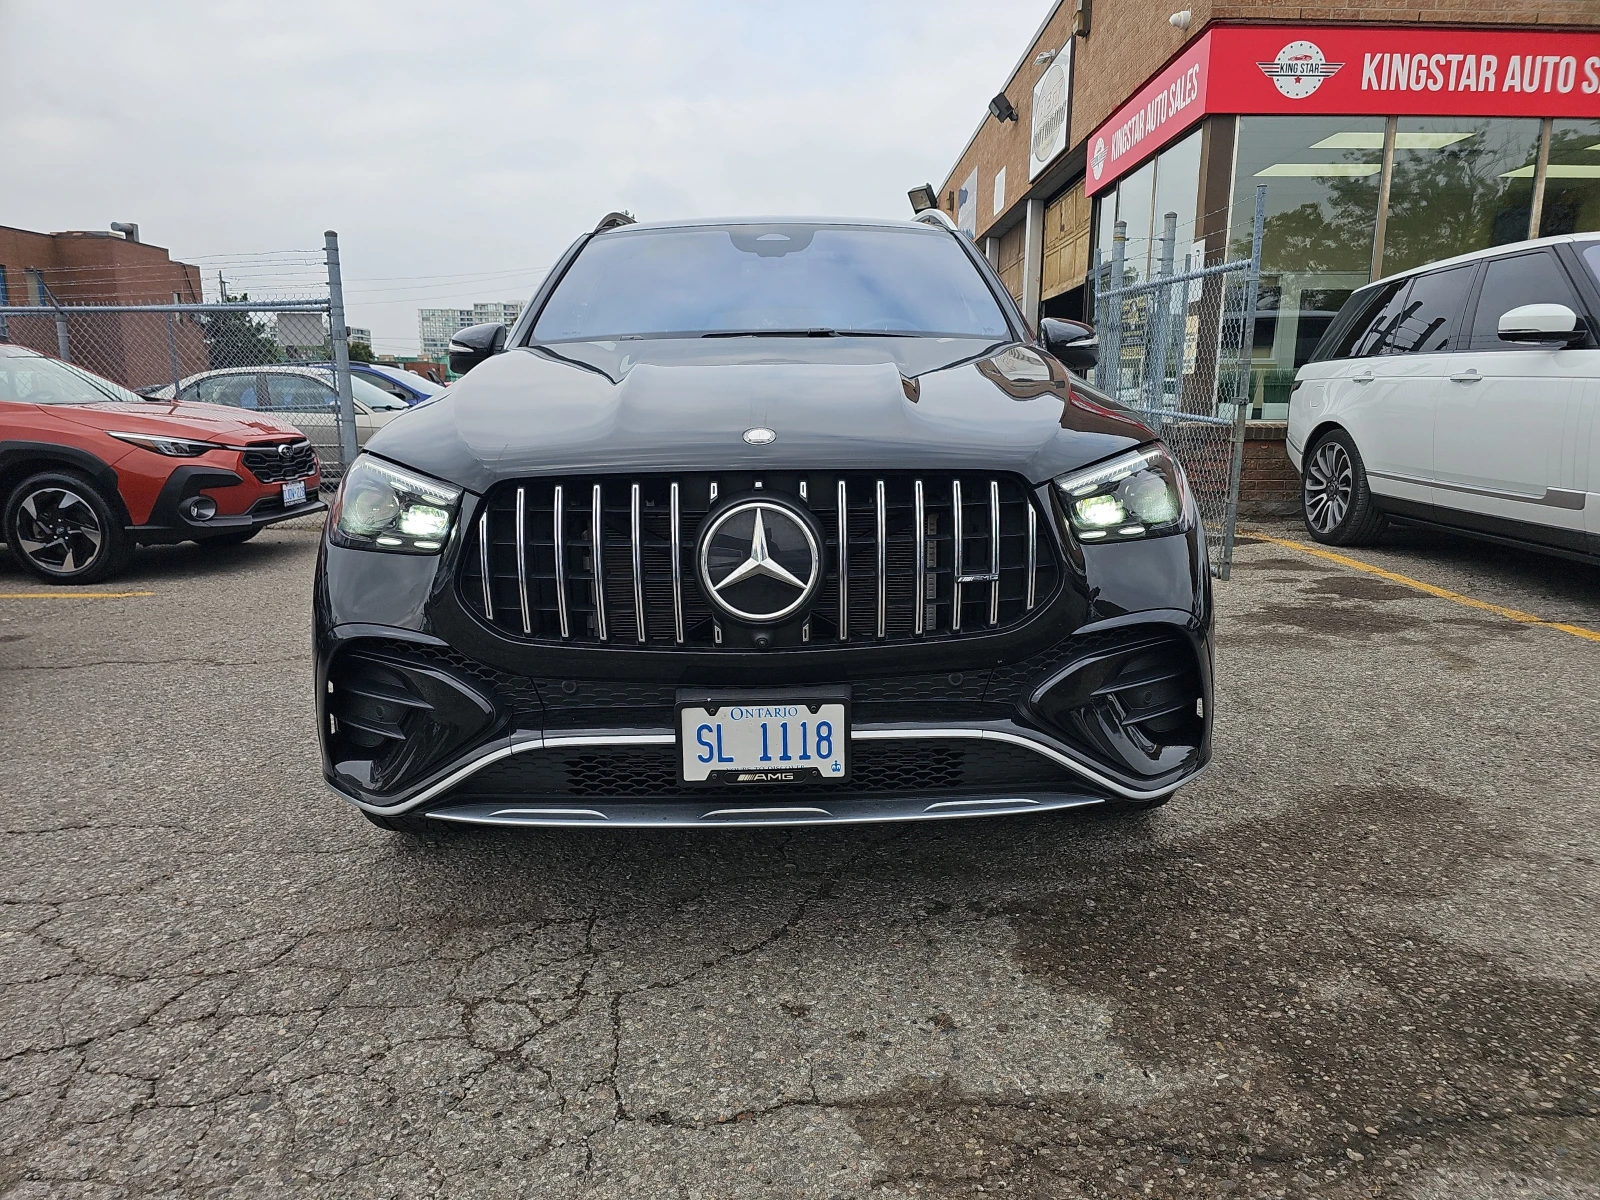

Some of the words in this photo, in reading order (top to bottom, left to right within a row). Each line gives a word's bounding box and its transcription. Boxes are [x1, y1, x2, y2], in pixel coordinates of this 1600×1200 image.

[1280, 62, 1298, 74] KING
[1300, 62, 1320, 74] STAR
[1361, 53, 1498, 92] KINGSTAR
[1502, 55, 1577, 94] AUTO
[1581, 57, 1600, 94] S
[1111, 109, 1145, 162] KINGSTAR
[1146, 89, 1168, 136] AUTO
[1169, 63, 1199, 118] SALES
[696, 723, 734, 763] SL
[759, 720, 833, 761] 1118
[754, 773, 794, 781] AMG
